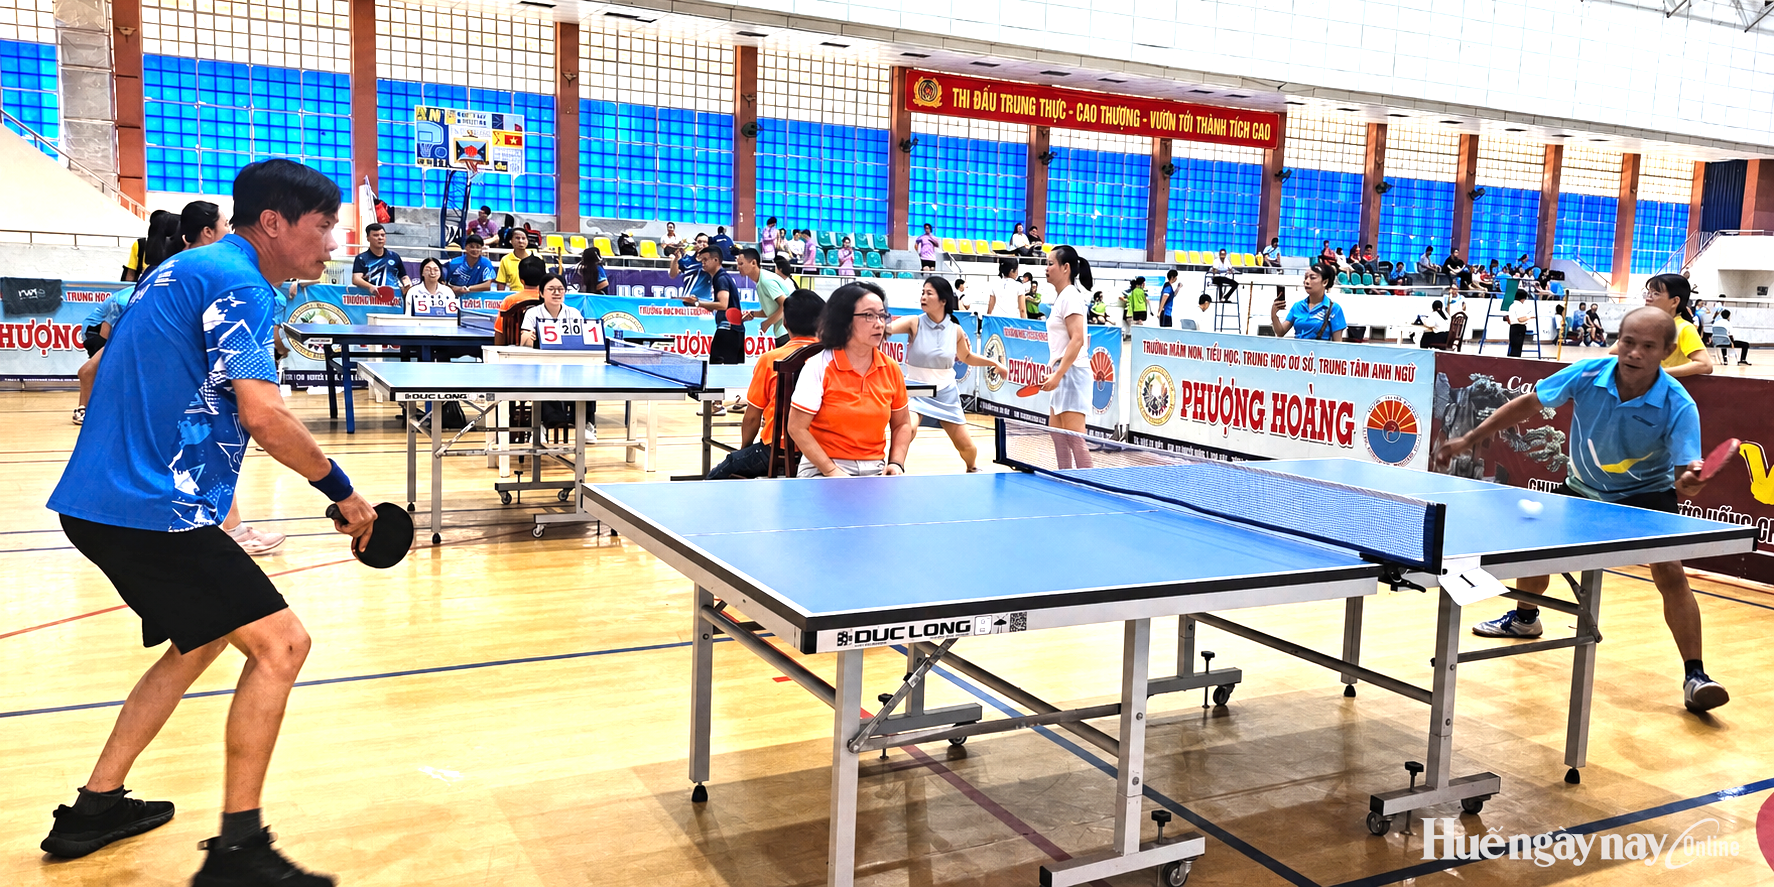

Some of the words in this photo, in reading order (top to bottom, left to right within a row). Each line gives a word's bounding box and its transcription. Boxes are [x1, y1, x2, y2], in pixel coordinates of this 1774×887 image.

[952, 87, 970, 109] THI
[973, 85, 997, 112] ĐẤU
[1000, 93, 1036, 116] TRUNG
[1039, 98, 1067, 123] THỰC
[1076, 102, 1097, 123] CAO
[1100, 104, 1140, 131] THƯỢNG
[1178, 110, 1194, 133] TỚI
[1196, 113, 1227, 136] THÀNH
[1229, 115, 1250, 139] TÍCH
[1252, 122, 1271, 141] CAO
[66, 291, 93, 302] TRUNG
[417, 300, 428, 312] 5
[448, 301, 458, 312] 6
[543, 325, 558, 342] 5
[588, 326, 599, 343] 1
[1243, 351, 1269, 367] TRUNG
[1270, 353, 1287, 372] HỌC
[1319, 358, 1347, 376] TRUNG
[1350, 358, 1370, 378] TÂM
[1371, 363, 1392, 380] ANH
[1507, 376, 1538, 394] Ca
[1180, 376, 1266, 436] PHƯỢNG
[1270, 383, 1355, 446] HOÀNG
[854, 625, 906, 644] DUC
[908, 619, 971, 638] LONG
